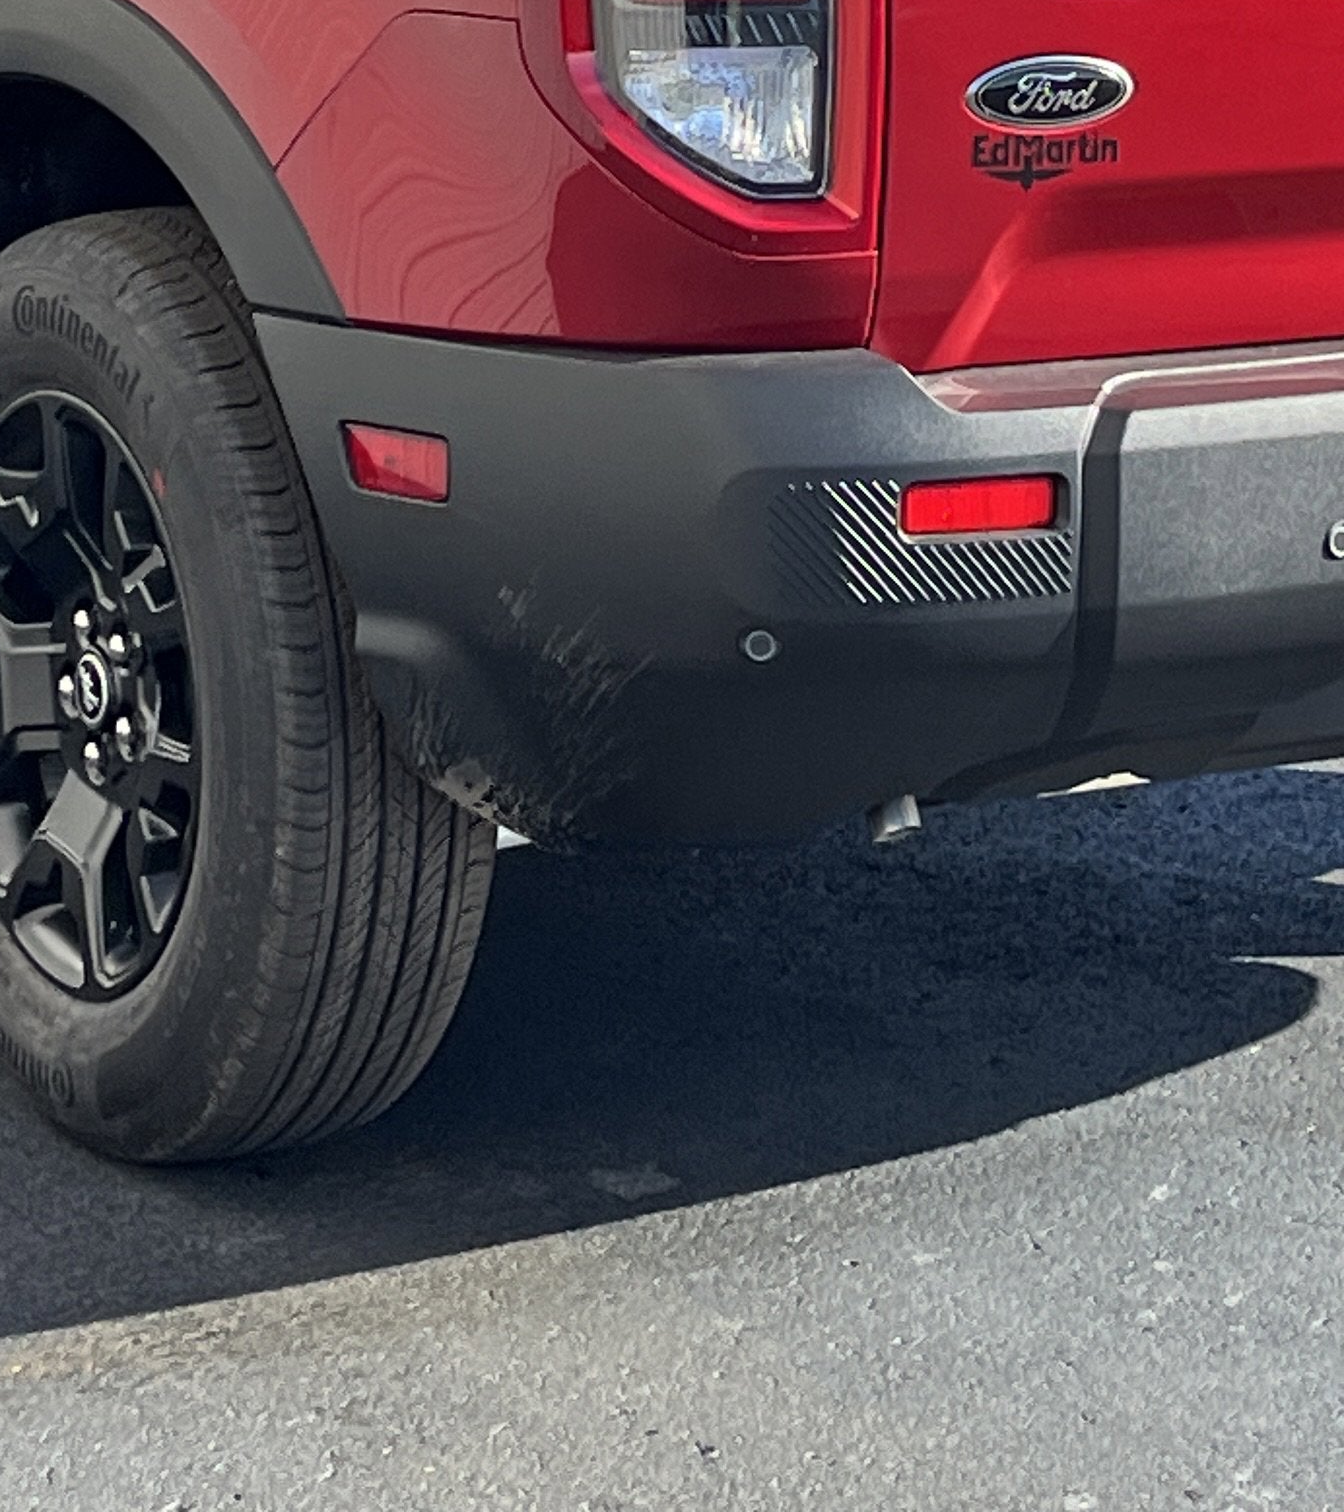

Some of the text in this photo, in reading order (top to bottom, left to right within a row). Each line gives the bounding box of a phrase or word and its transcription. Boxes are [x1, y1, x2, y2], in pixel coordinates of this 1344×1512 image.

[1007, 71, 1099, 116] Ford
[971, 133, 1120, 168] EdMartin
[11, 284, 142, 405] Continental
